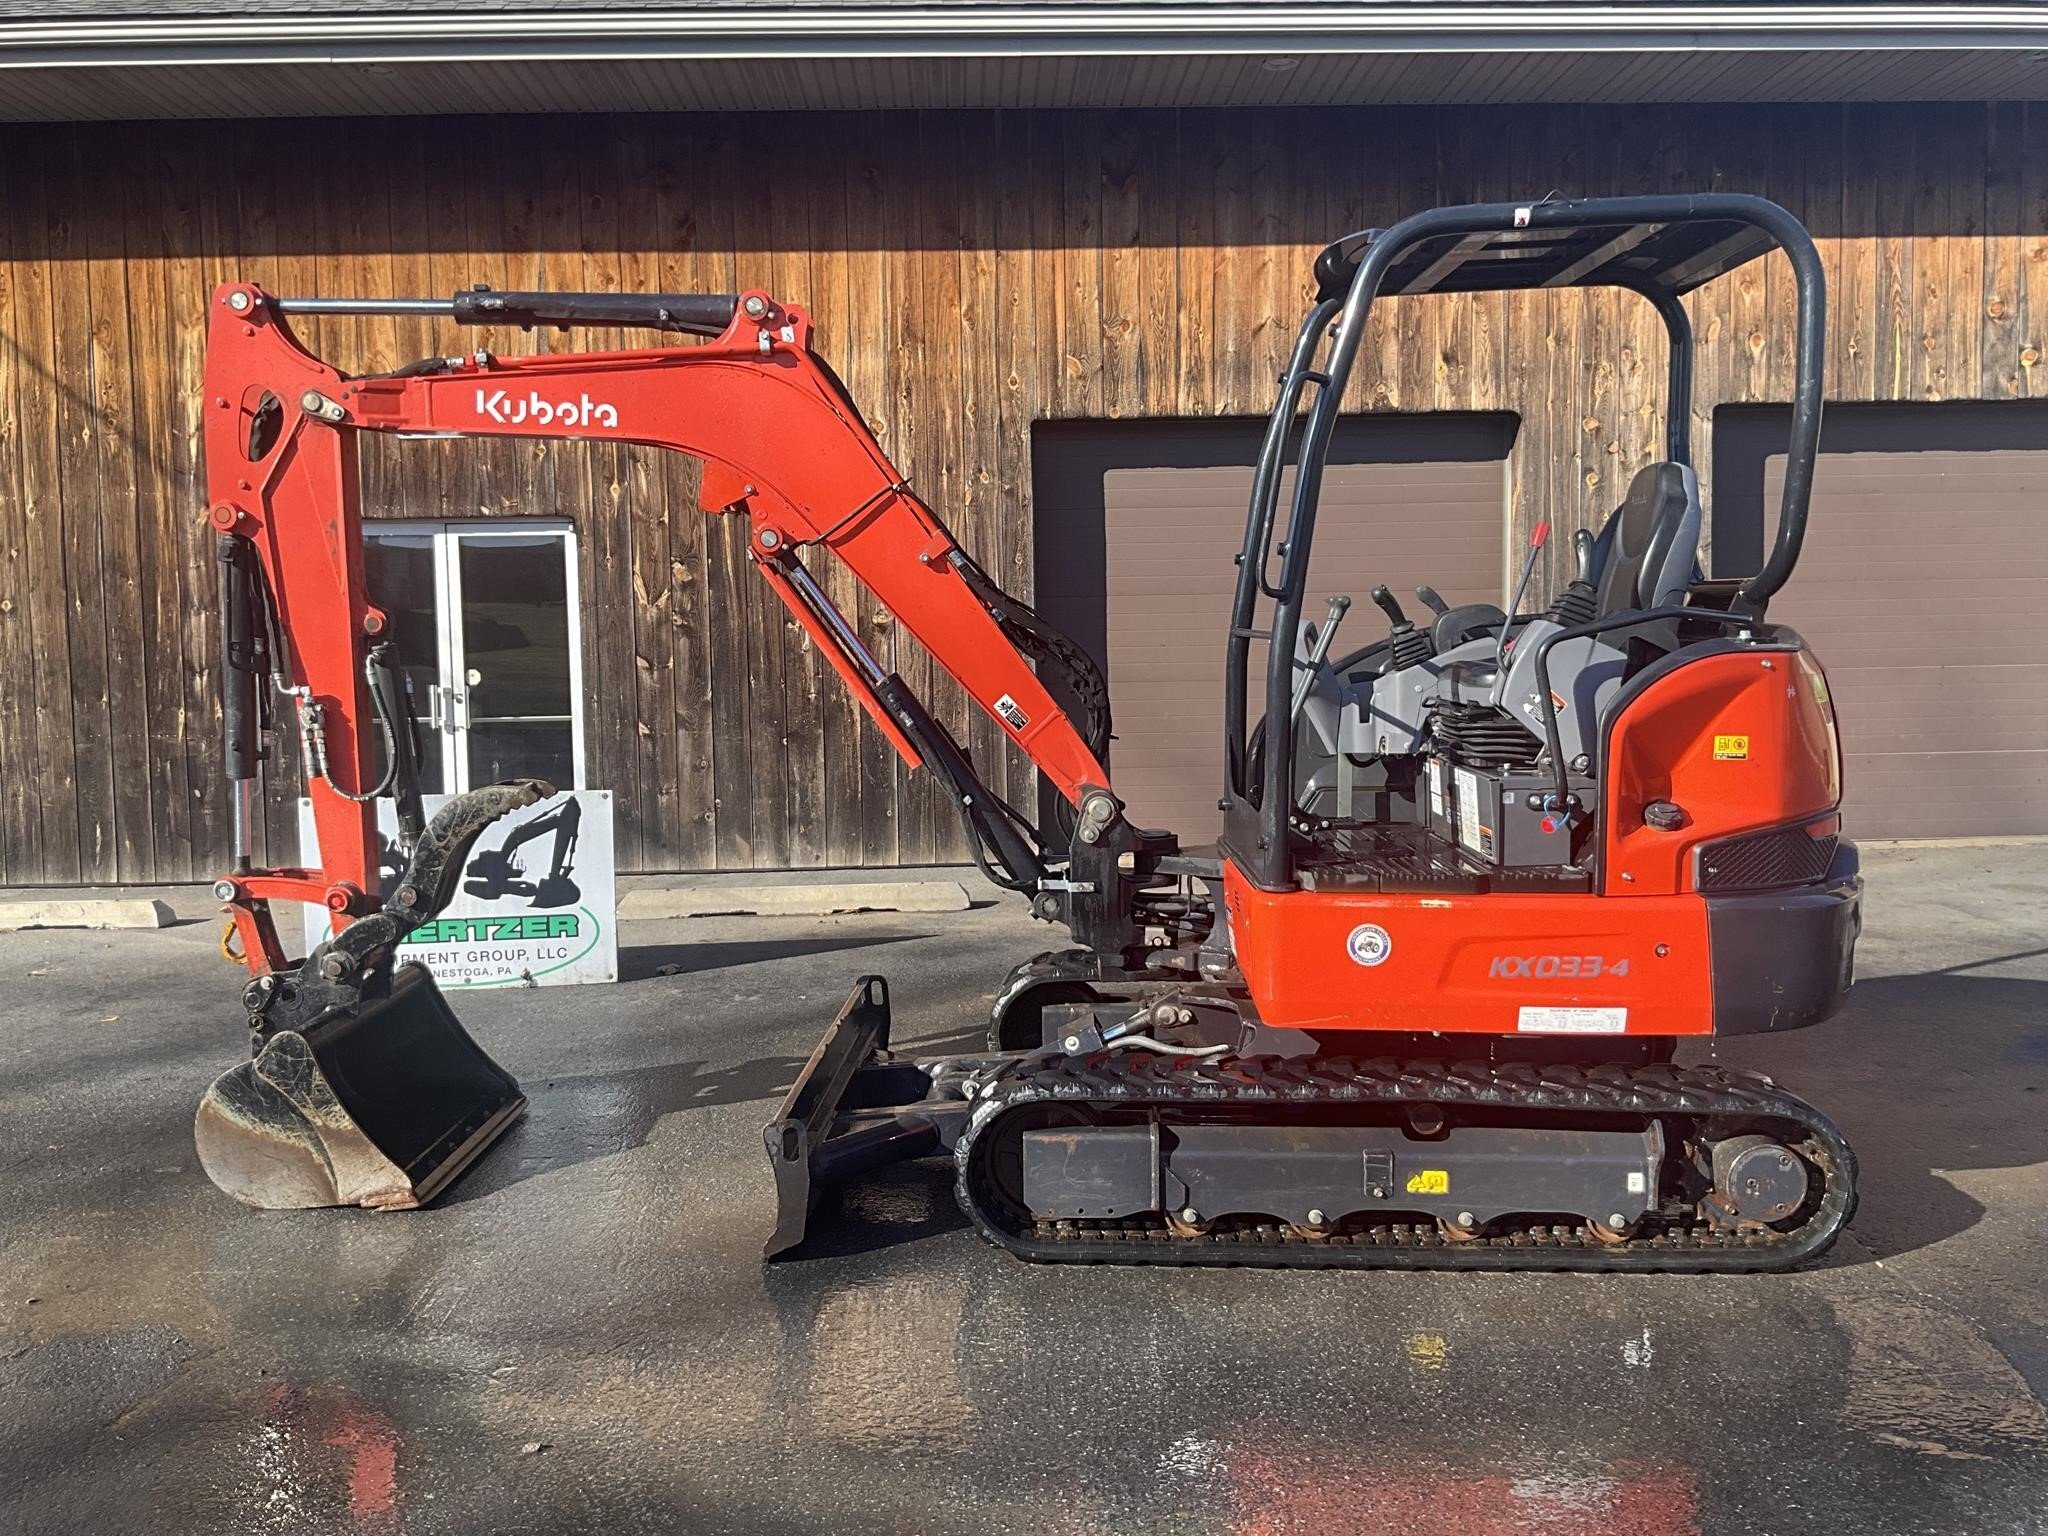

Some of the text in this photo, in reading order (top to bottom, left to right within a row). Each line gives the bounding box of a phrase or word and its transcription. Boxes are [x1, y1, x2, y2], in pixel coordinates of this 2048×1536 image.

[476, 389, 618, 428] Kubota
[400, 913, 580, 944] ERTZER
[466, 949, 530, 963] GROUP,
[537, 947, 568, 960] LLC
[1488, 955, 1630, 979] KX033-4
[497, 966, 513, 975] PA
